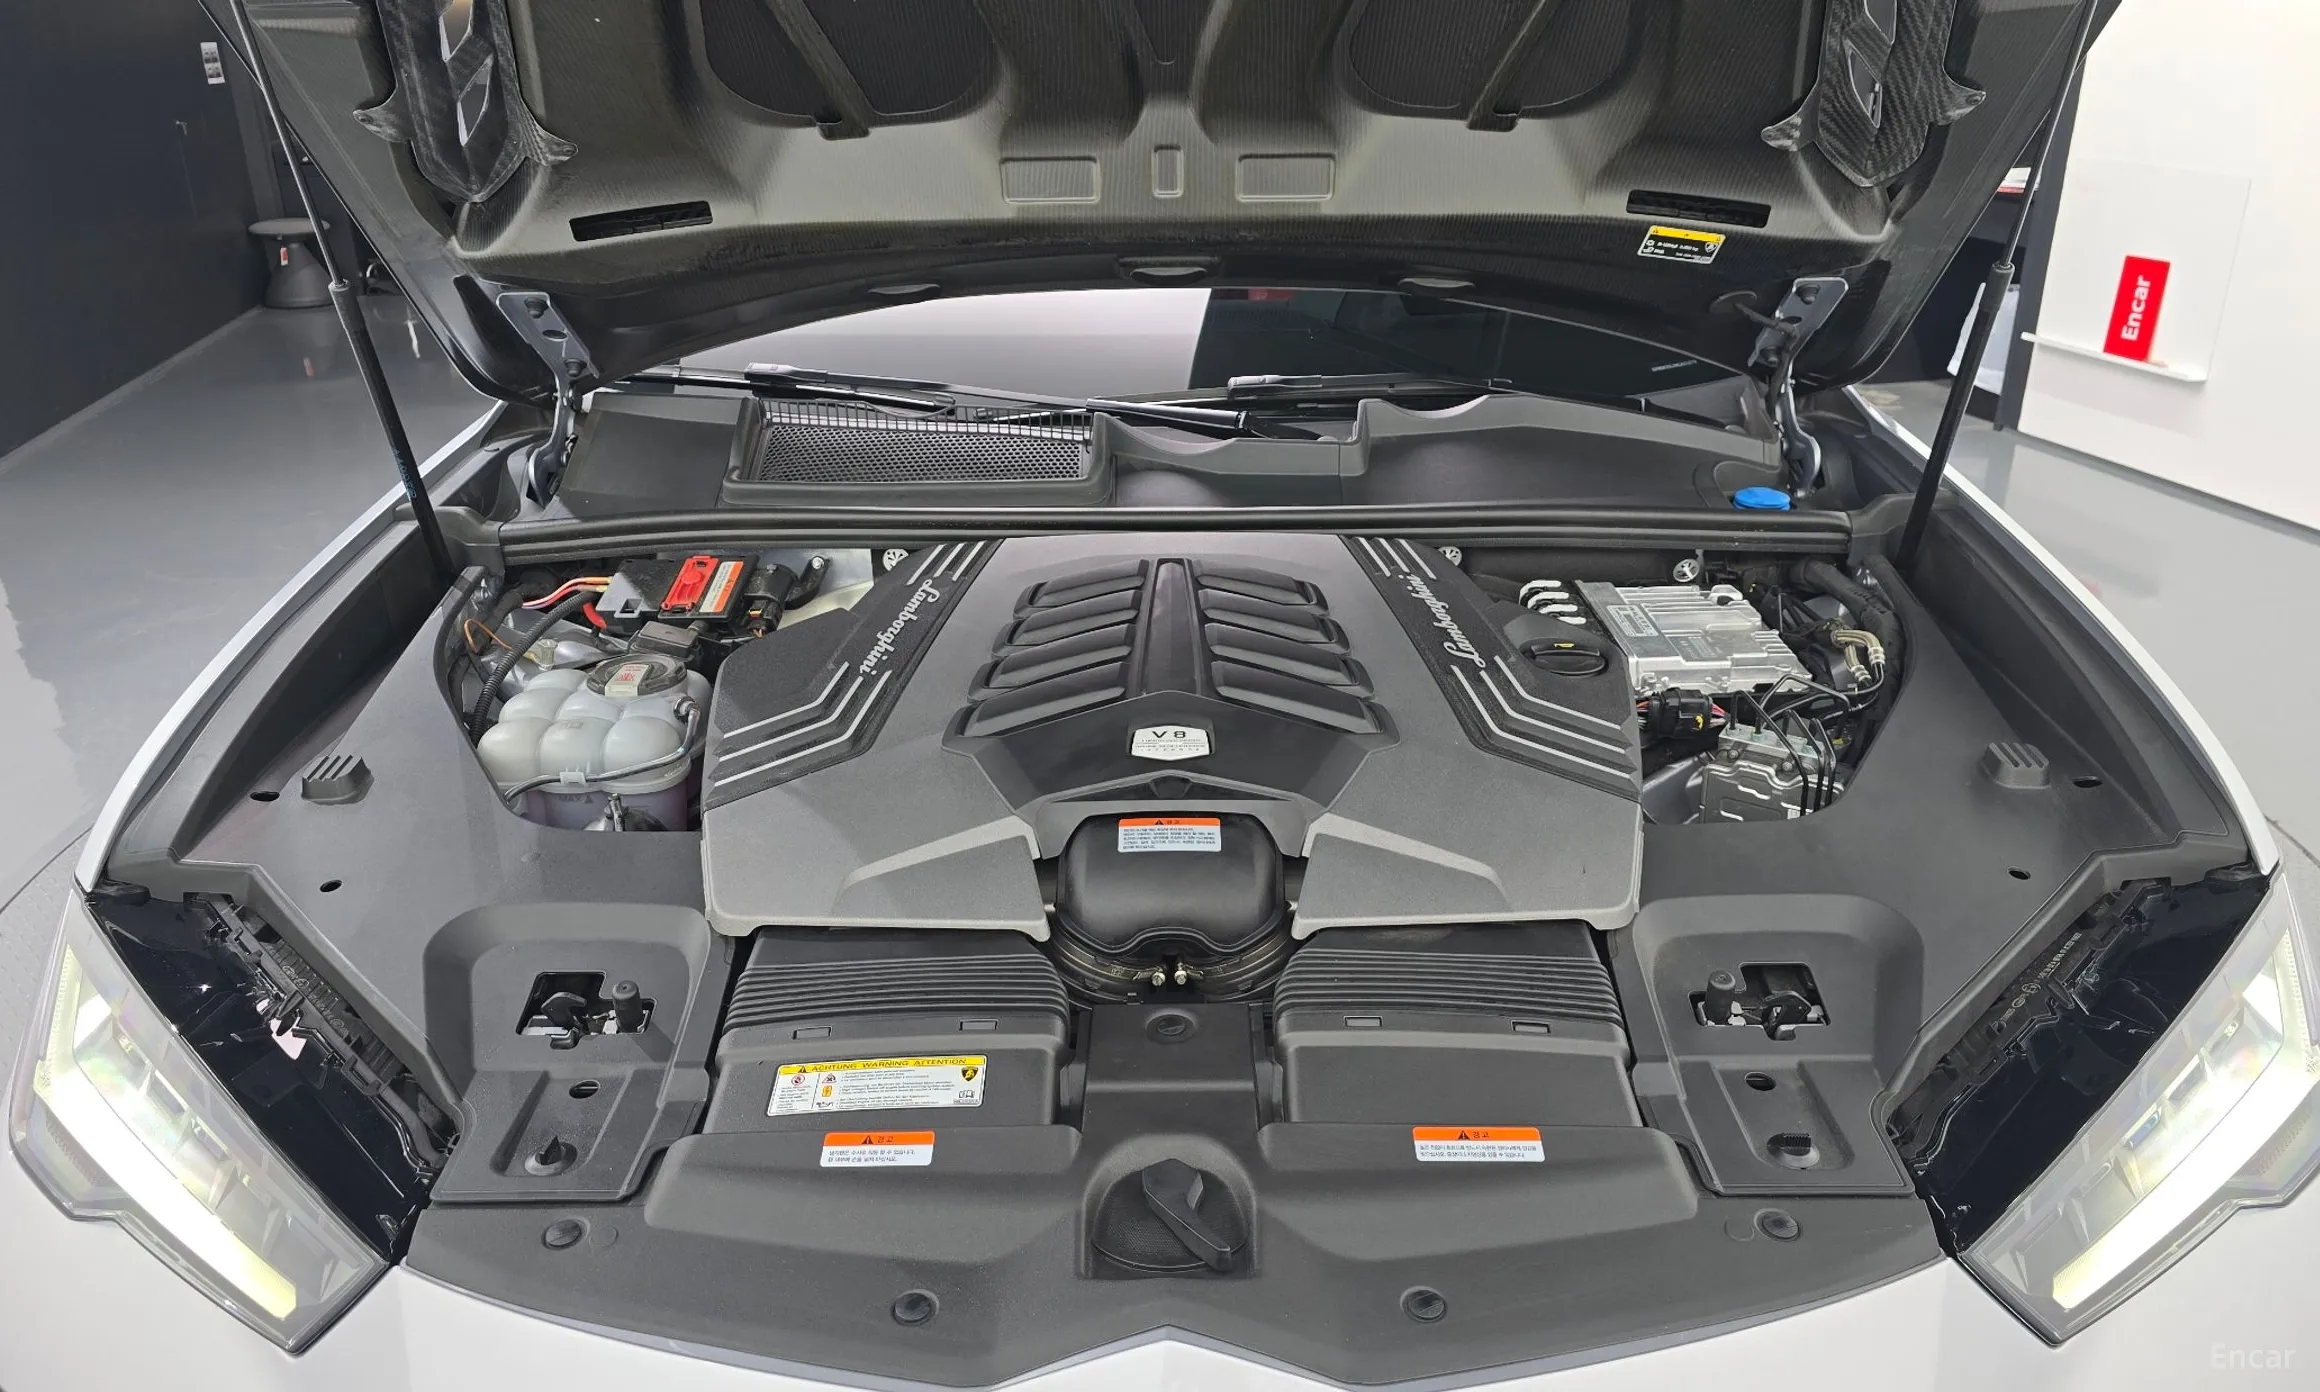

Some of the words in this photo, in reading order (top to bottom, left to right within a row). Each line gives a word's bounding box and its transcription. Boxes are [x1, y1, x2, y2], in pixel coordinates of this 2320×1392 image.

[2120, 274, 2152, 341] Encar
[859, 579, 940, 676] Lamborghini
[1398, 573, 1486, 668] Lamborghini
[811, 1063, 857, 1072] ACHTUNG
[862, 1060, 909, 1069] WARNING
[914, 1059, 967, 1067] ATTENTION
